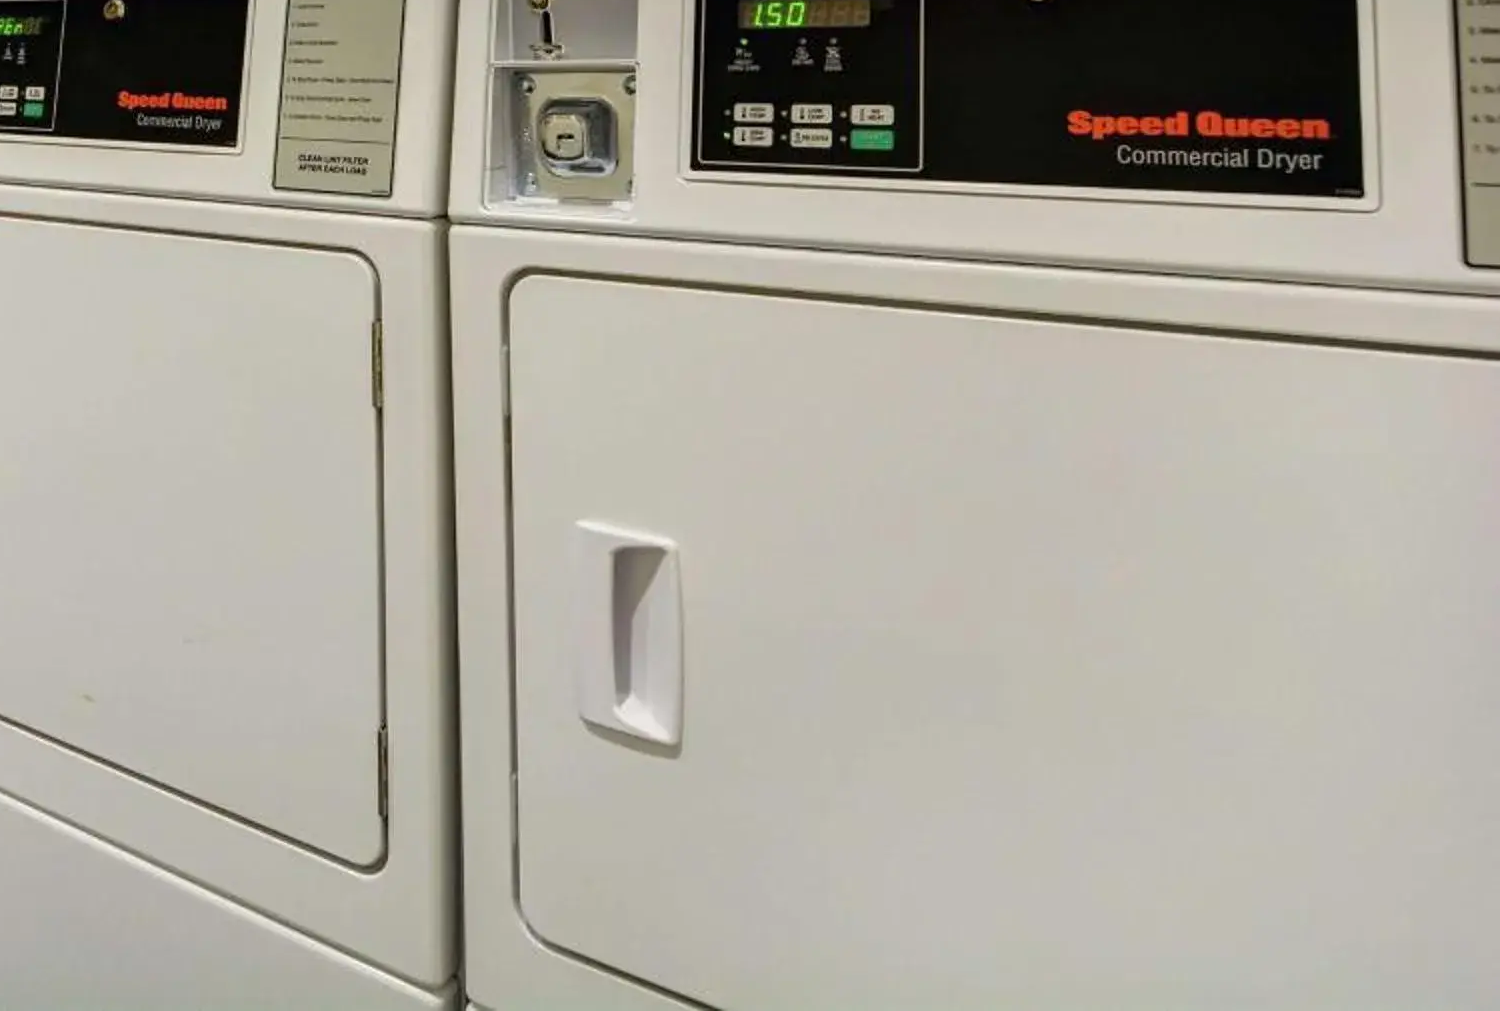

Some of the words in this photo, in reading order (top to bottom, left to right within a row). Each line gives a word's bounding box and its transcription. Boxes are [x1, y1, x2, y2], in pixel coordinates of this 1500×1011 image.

[117, 90, 170, 111] Speed
[172, 92, 227, 110] Queen
[137, 112, 192, 128] Commercial
[195, 115, 222, 132] Dryer
[1067, 110, 1189, 139] Speed
[1196, 111, 1330, 139] Queen
[1116, 144, 1250, 168] Commercial
[1257, 148, 1324, 174] Dryer
